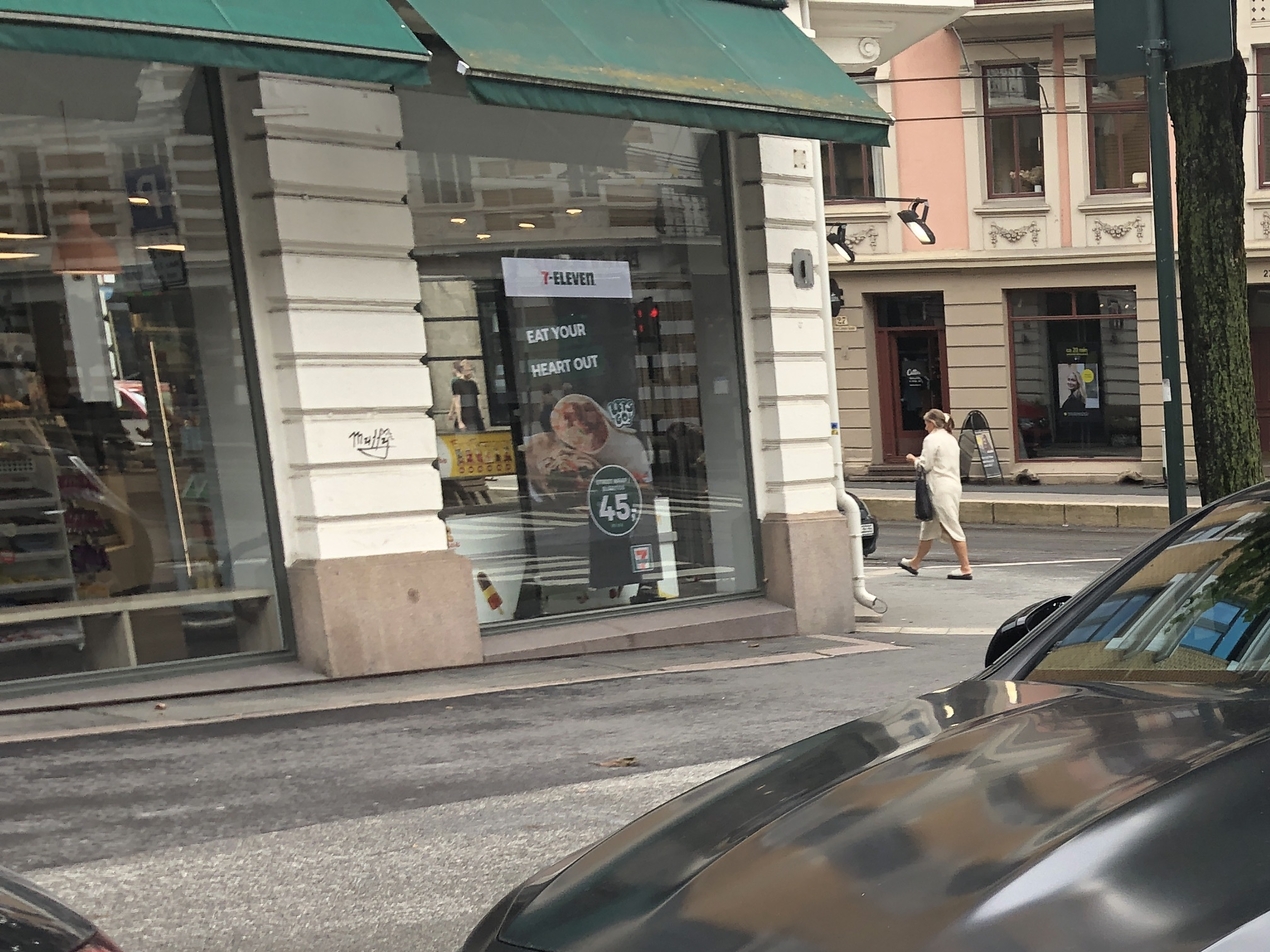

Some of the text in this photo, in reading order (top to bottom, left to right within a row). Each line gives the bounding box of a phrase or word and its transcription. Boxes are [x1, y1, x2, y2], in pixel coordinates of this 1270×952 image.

[526, 323, 586, 344] EAT YOUR
[530, 355, 598, 378] HEART OUT
